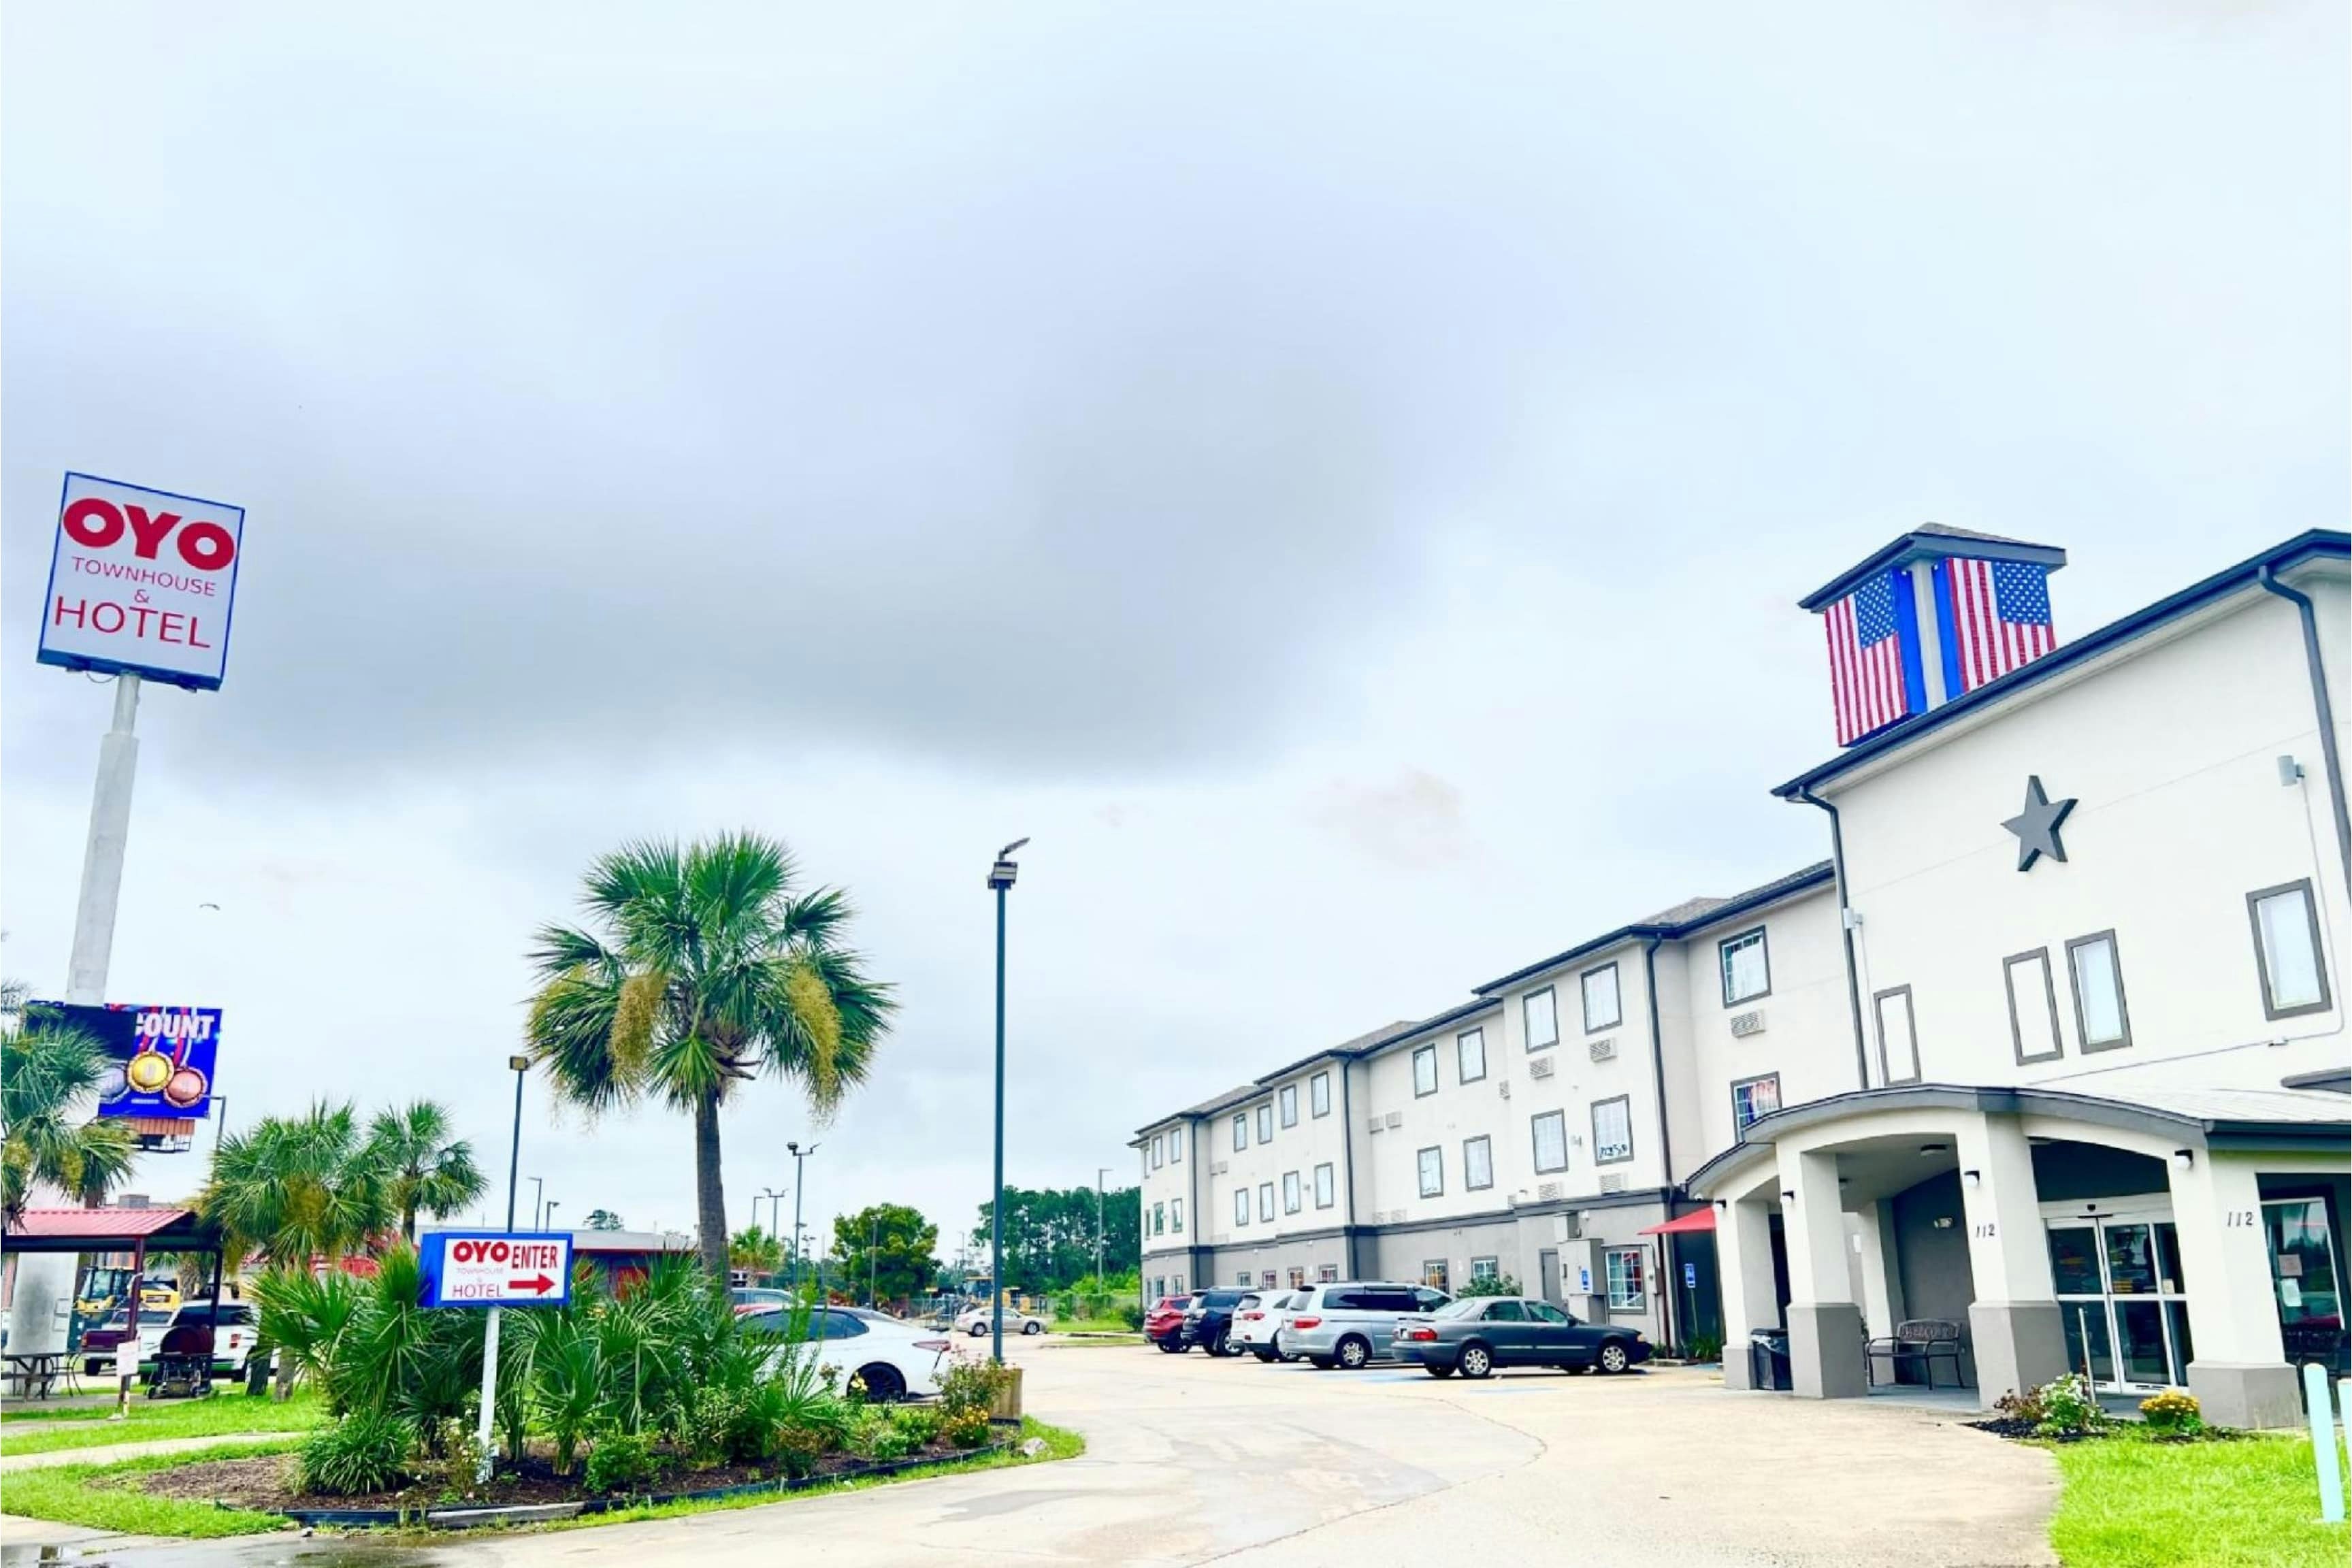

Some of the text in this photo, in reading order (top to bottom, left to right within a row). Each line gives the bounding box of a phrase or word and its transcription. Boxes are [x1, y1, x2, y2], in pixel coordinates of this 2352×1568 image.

[63, 497, 235, 571] OYO
[71, 556, 216, 597] TOWNHOUSE
[134, 589, 150, 604] &
[55, 595, 211, 648] HOTEL
[2227, 1211, 2253, 1227] 112
[1976, 1223, 1995, 1238] 112
[453, 1241, 509, 1262] OYO
[512, 1245, 558, 1269] ENTER
[452, 1284, 504, 1298] HOTEL
